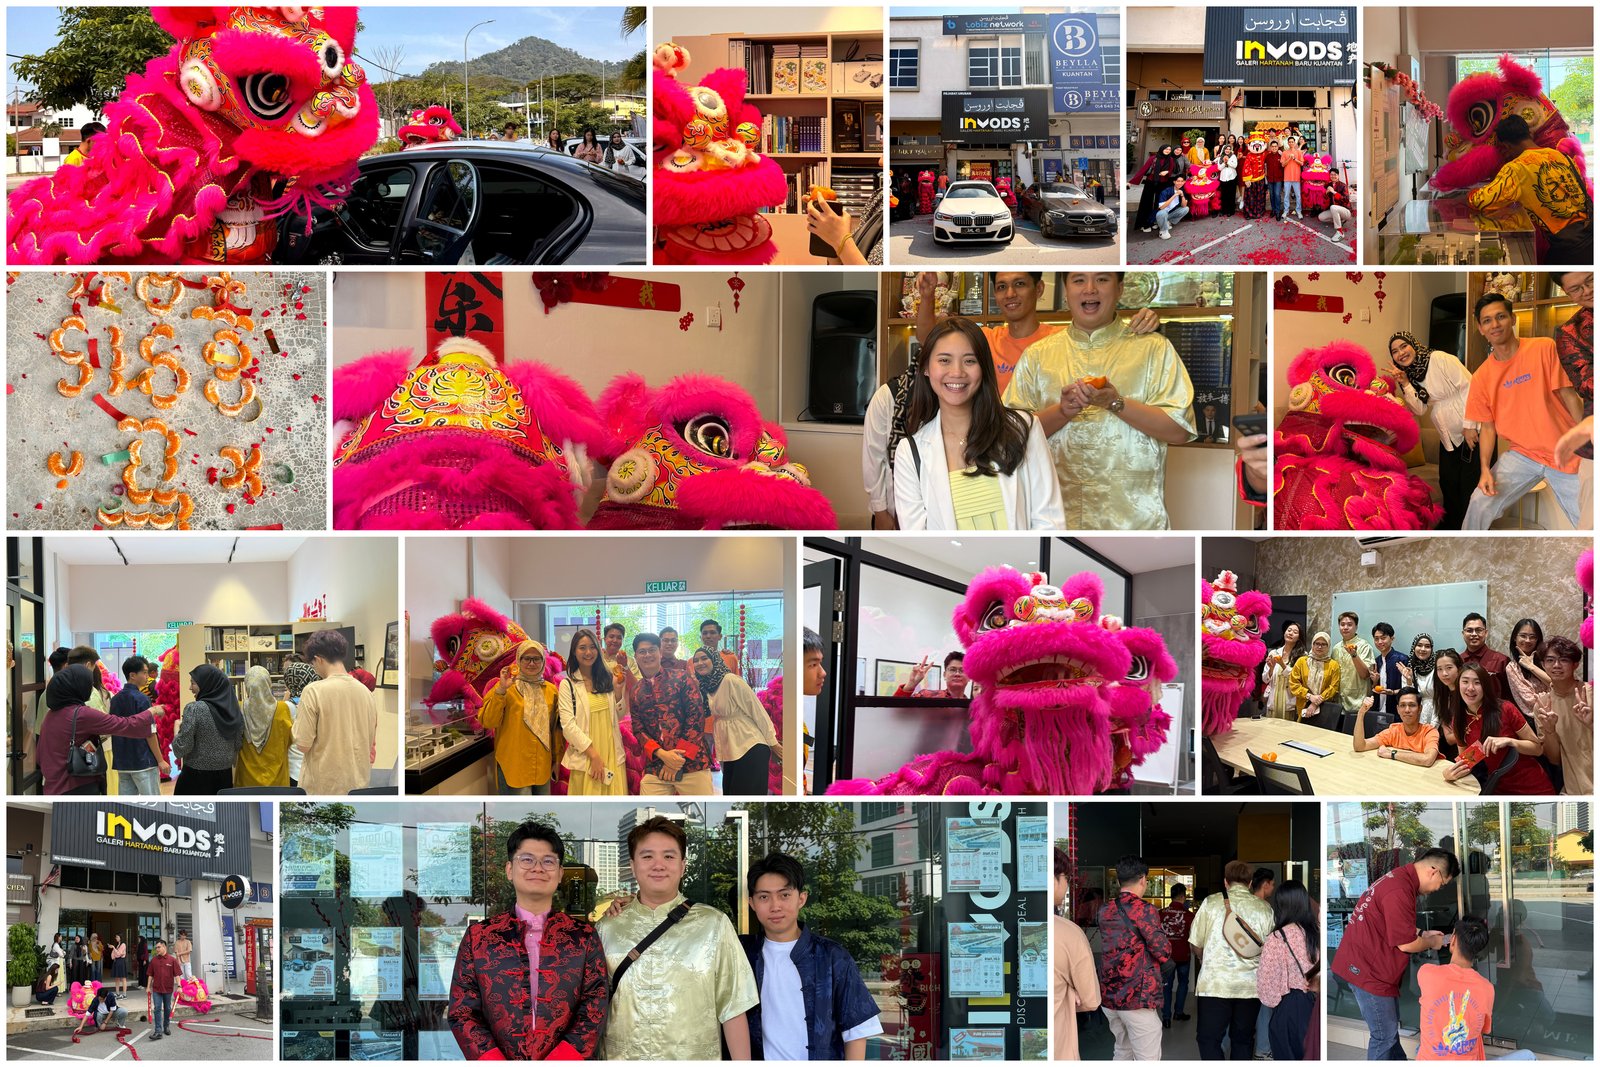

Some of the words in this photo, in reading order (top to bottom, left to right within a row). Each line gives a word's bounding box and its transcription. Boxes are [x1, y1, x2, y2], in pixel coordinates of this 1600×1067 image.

[646, 581, 678, 592] KELUAR
[96, 836, 124, 847] GALERI
[125, 840, 163, 852] HARTANAH
[163, 847, 182, 855] BARU
[182, 849, 212, 859] KUANTAN
[920, 984, 941, 992] RICH
